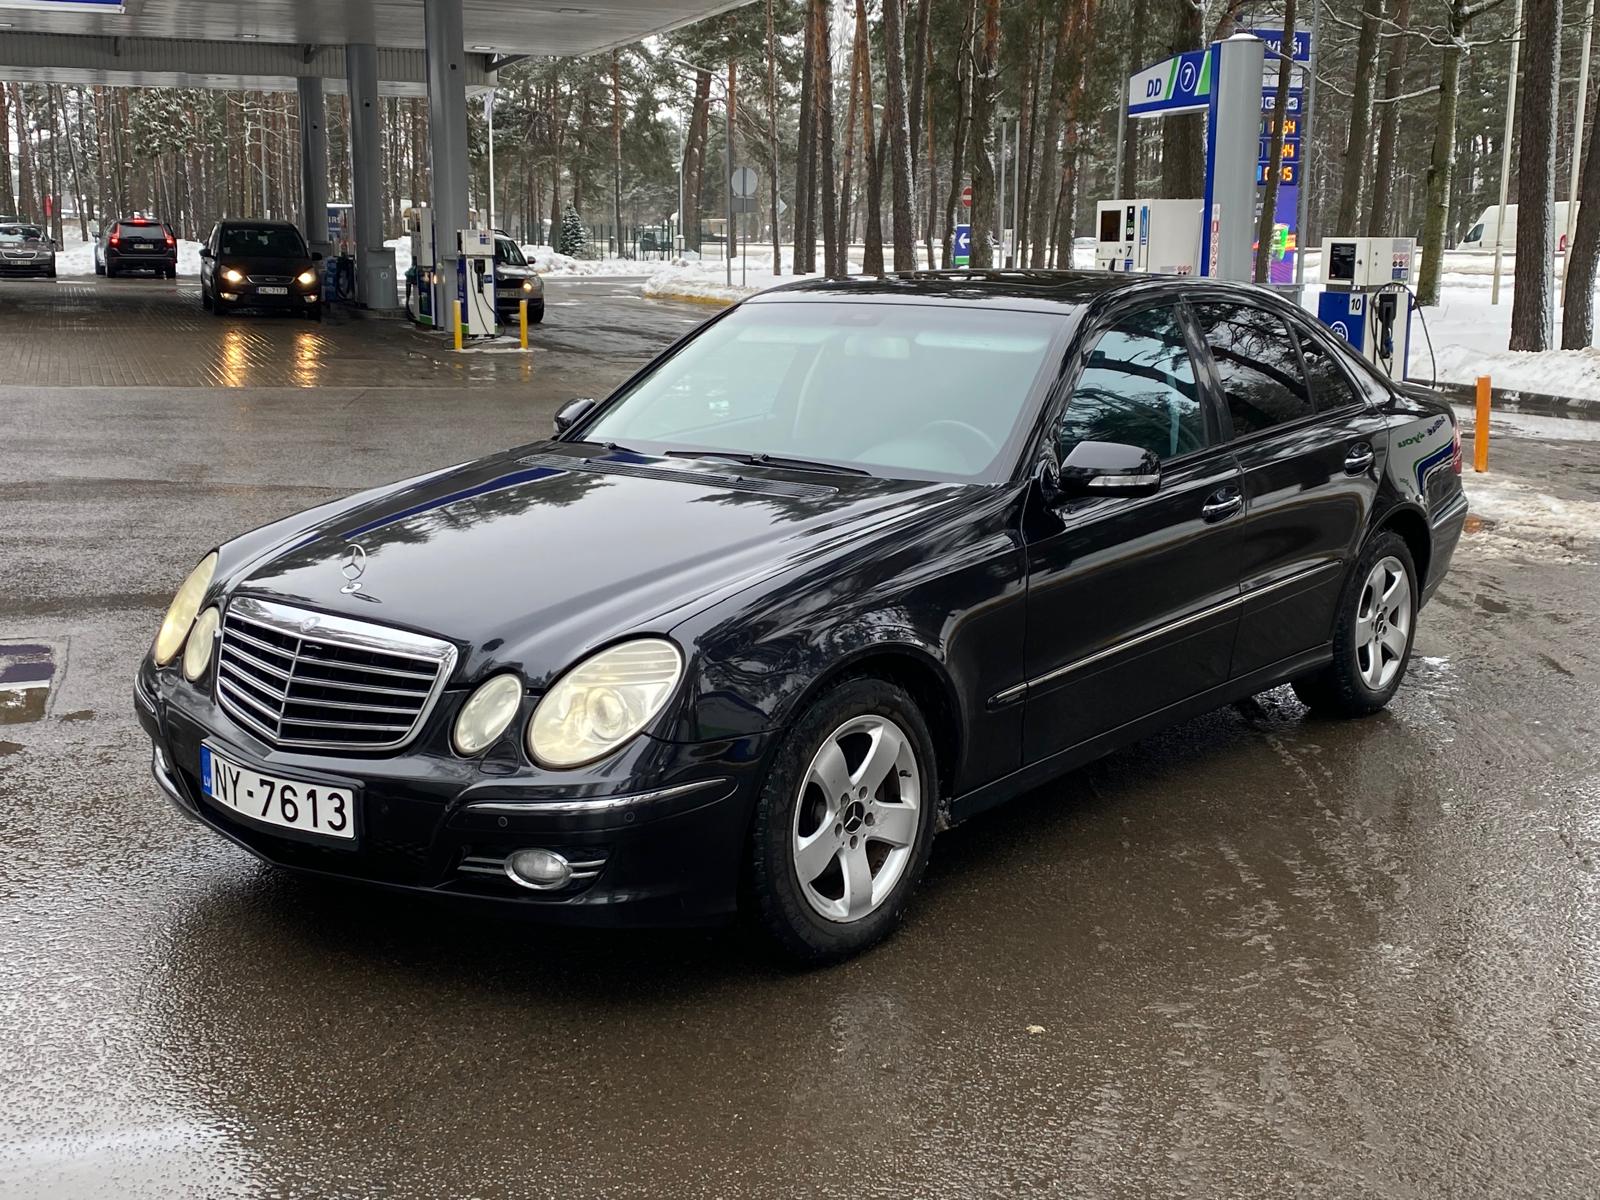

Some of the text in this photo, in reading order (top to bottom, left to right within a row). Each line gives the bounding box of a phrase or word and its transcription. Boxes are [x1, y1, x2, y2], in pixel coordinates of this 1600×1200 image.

[1146, 68, 1192, 97] DD 7
[1127, 246, 1133, 257] 7
[1351, 298, 1361, 311] 10
[204, 776, 211, 787] LV
[214, 758, 347, 832] NY-7613
